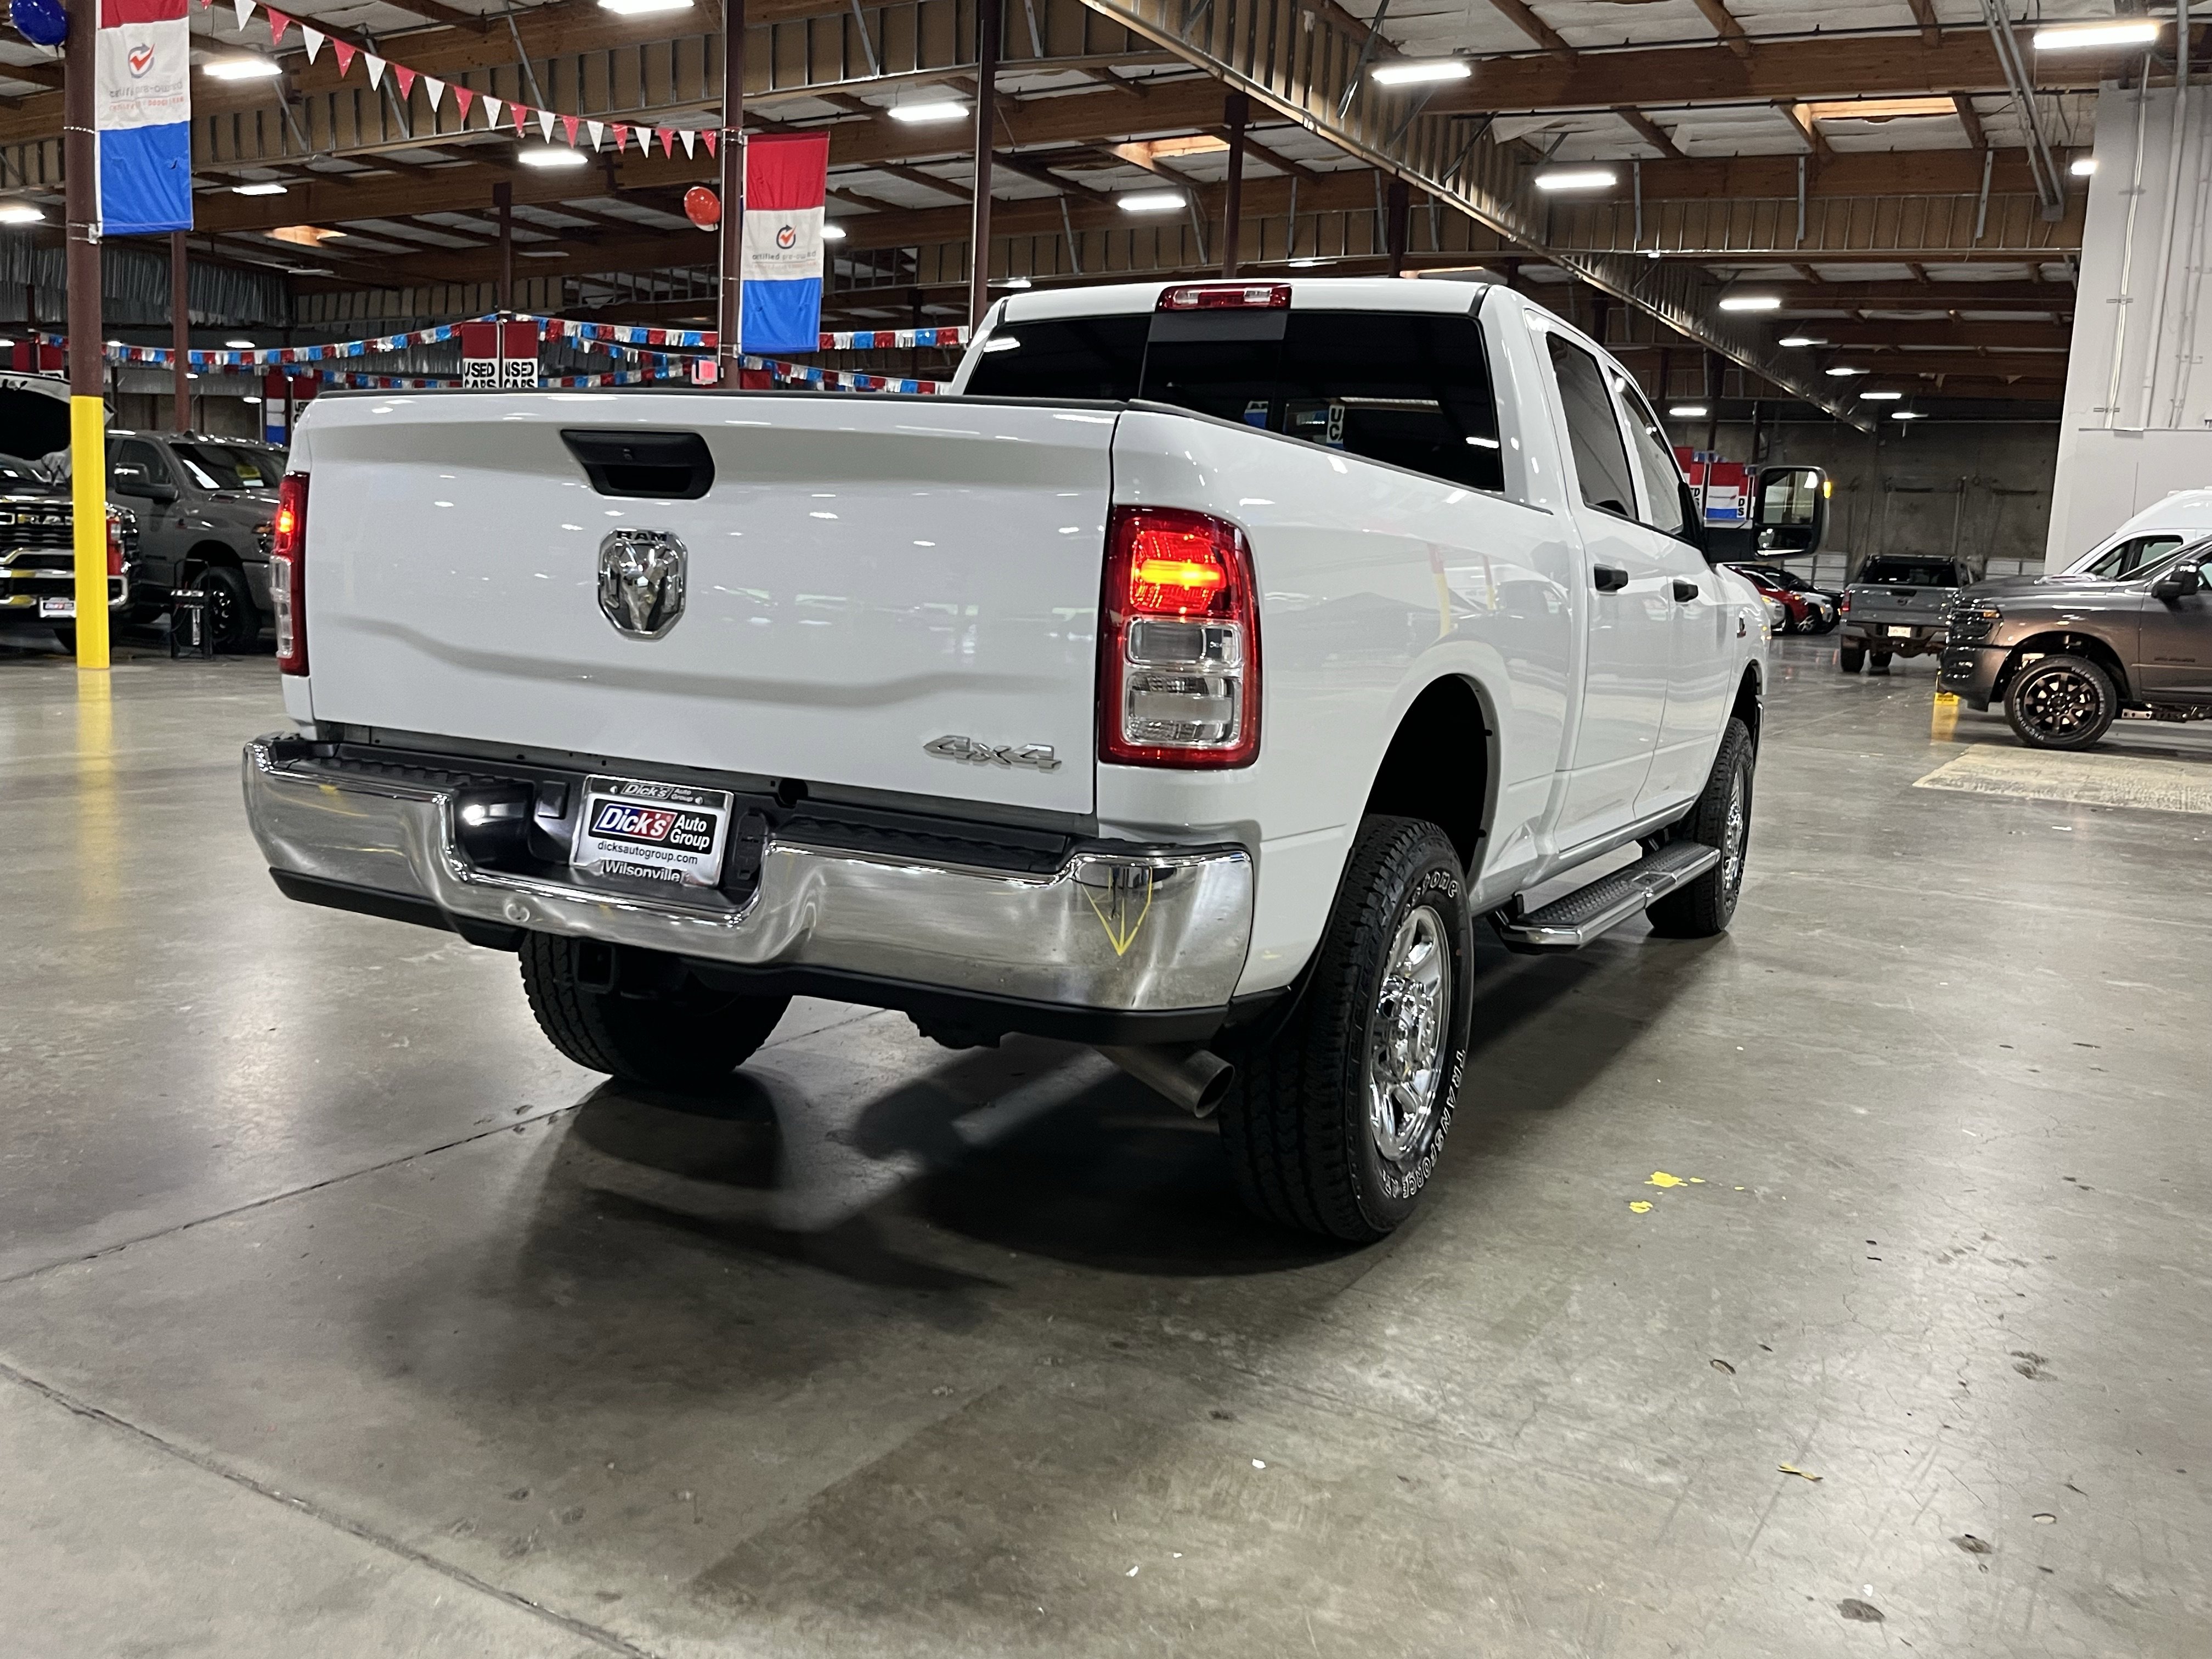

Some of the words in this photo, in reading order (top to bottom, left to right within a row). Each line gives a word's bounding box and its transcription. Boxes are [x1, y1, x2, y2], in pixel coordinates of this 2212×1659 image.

[464, 362, 495, 377] USED
[505, 362, 534, 377] USED
[617, 531, 668, 541] RAM
[599, 808, 667, 837] Dick's
[674, 814, 707, 832] Auto
[670, 828, 710, 850] Group
[597, 840, 698, 865] dicksautogroup.com
[605, 860, 680, 882] Wilsonville
